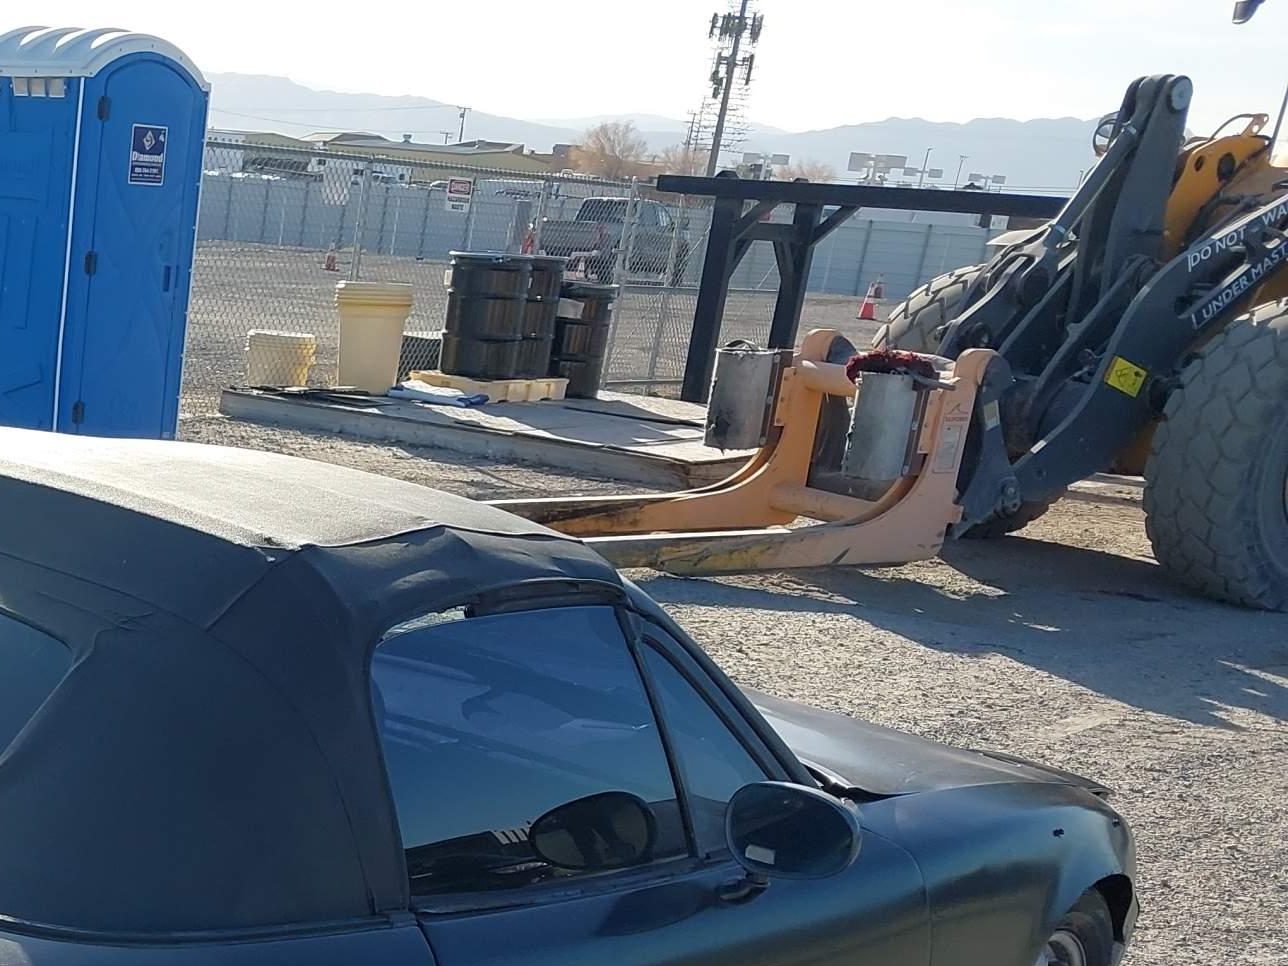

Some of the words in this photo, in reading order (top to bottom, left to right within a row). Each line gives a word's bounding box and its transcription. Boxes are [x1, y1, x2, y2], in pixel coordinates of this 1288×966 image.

[132, 151, 164, 163] Diamond
[1191, 246, 1212, 268] DO
[1215, 226, 1248, 254] NOT
[1262, 205, 1288, 226] WA
[1202, 278, 1249, 319] UNDER
